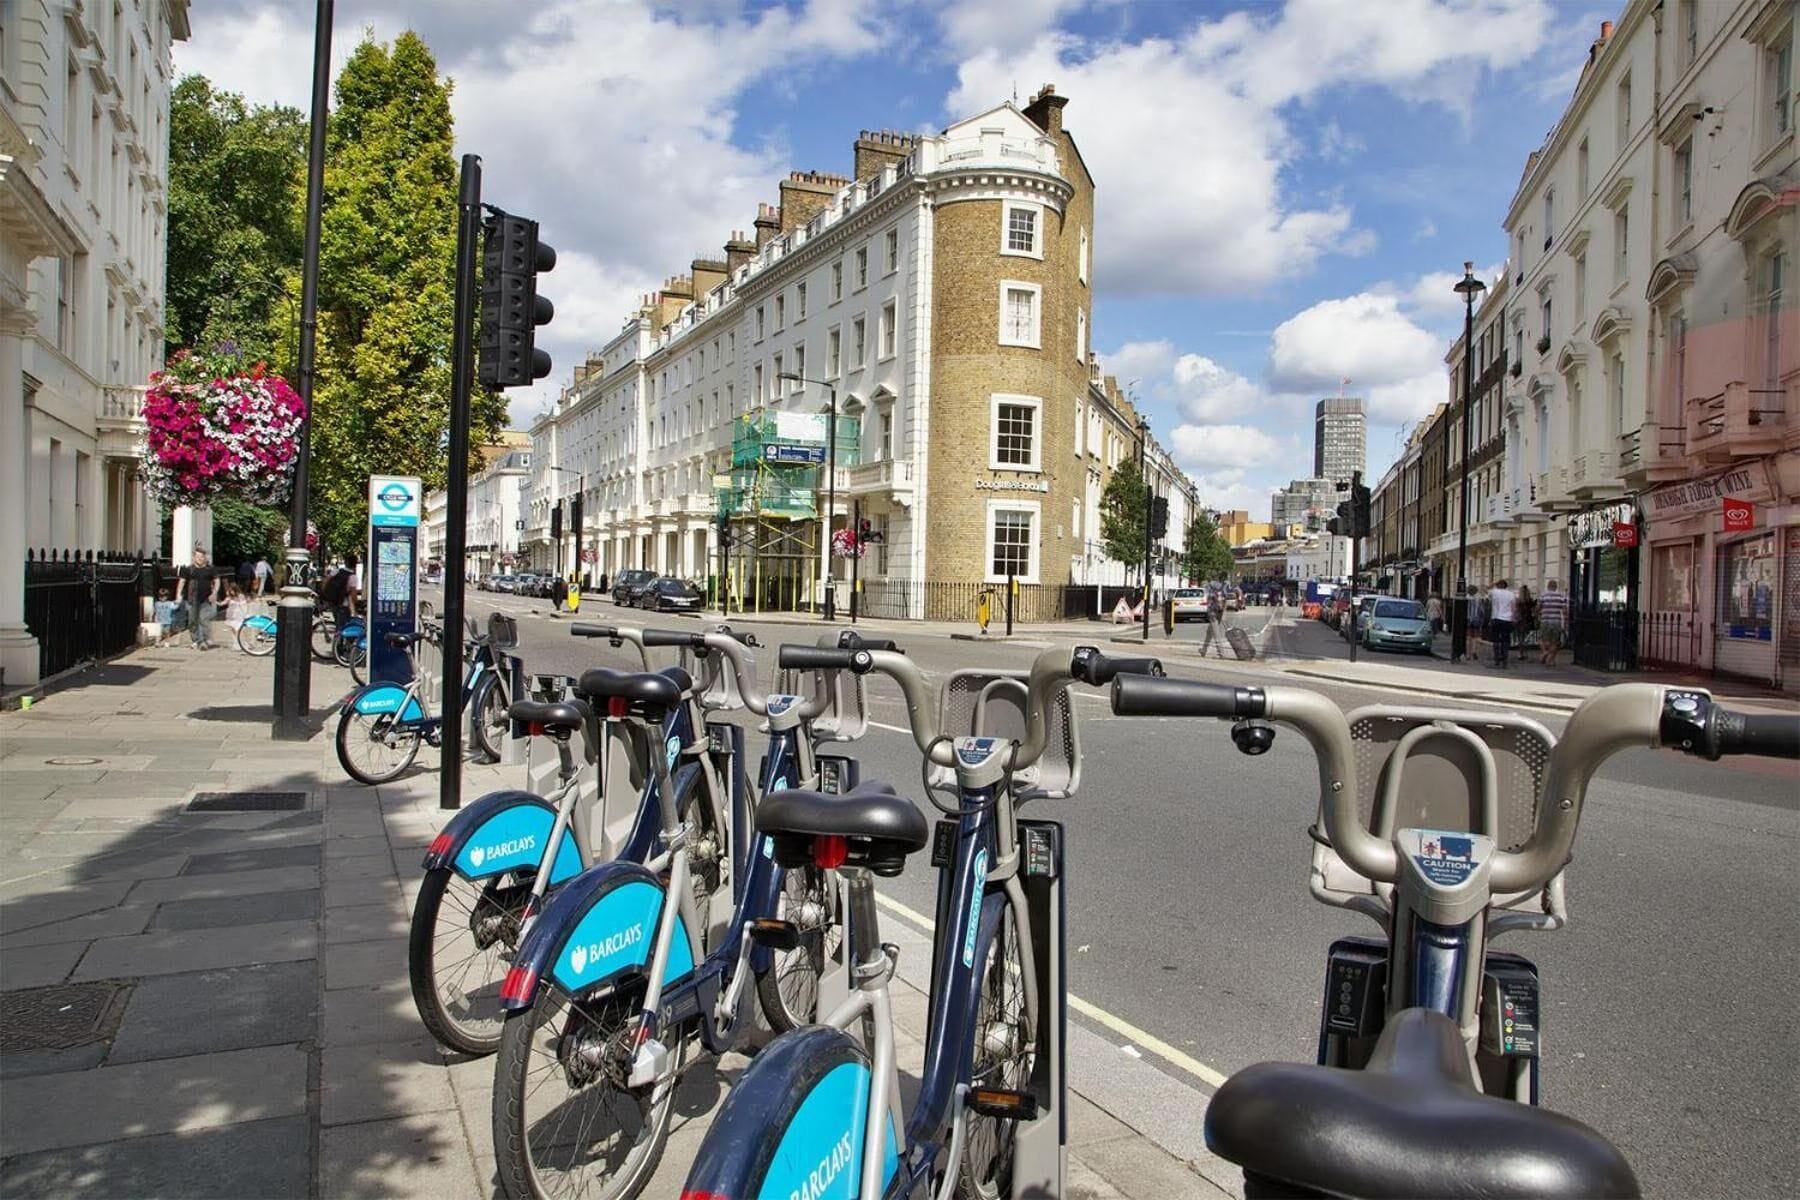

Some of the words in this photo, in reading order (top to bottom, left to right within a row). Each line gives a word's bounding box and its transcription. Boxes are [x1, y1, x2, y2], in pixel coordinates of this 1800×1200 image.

[1689, 480, 1712, 503] FOOD
[1714, 481, 1723, 497] &
[1725, 470, 1753, 494] WINE
[486, 835, 536, 860] BARCLAYS
[1422, 859, 1471, 870] CAUTION
[590, 923, 642, 964] BARCLAYS
